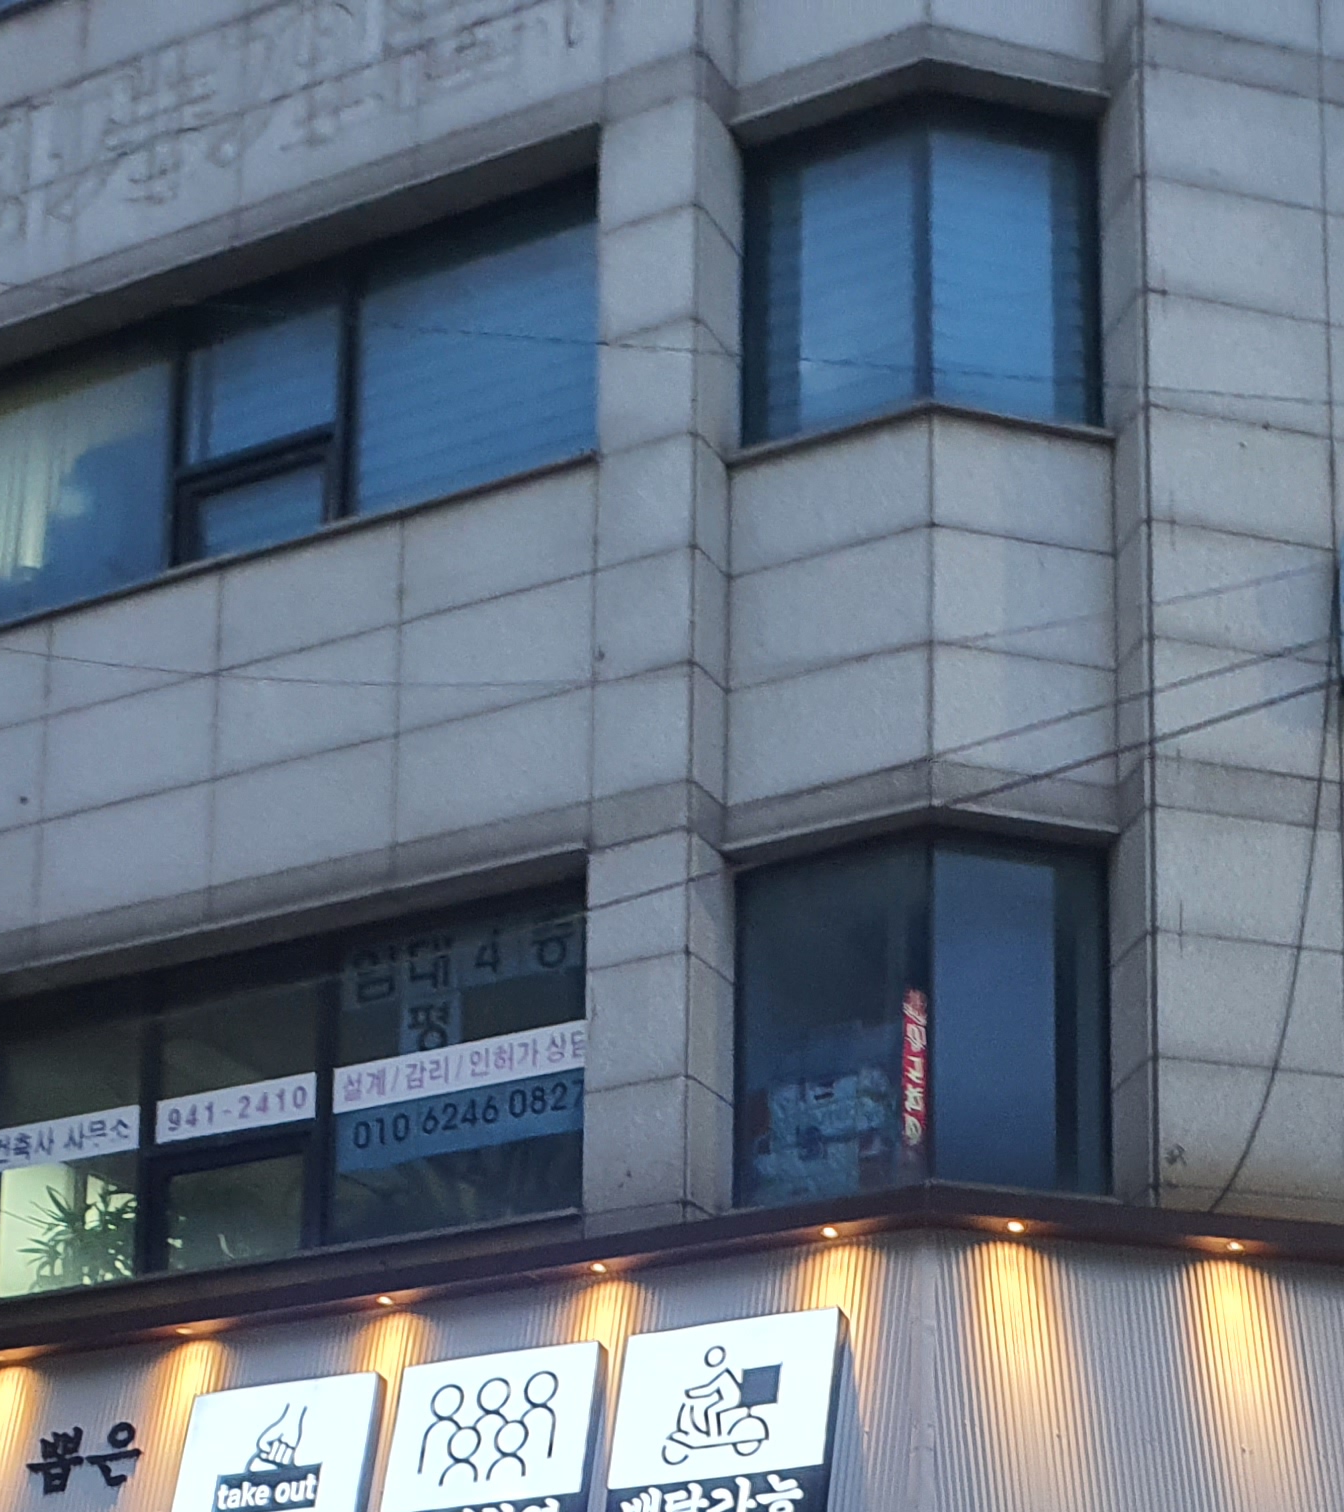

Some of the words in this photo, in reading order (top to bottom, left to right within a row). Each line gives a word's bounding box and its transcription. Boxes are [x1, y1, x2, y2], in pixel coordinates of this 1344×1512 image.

[167, 1085, 309, 1132] 941-2410
[353, 1111, 411, 1149] 010
[422, 1094, 500, 1136] 6246
[27, 1420, 142, 1495] 뽑은
[216, 1482, 269, 1512] take
[274, 1477, 317, 1505] out
